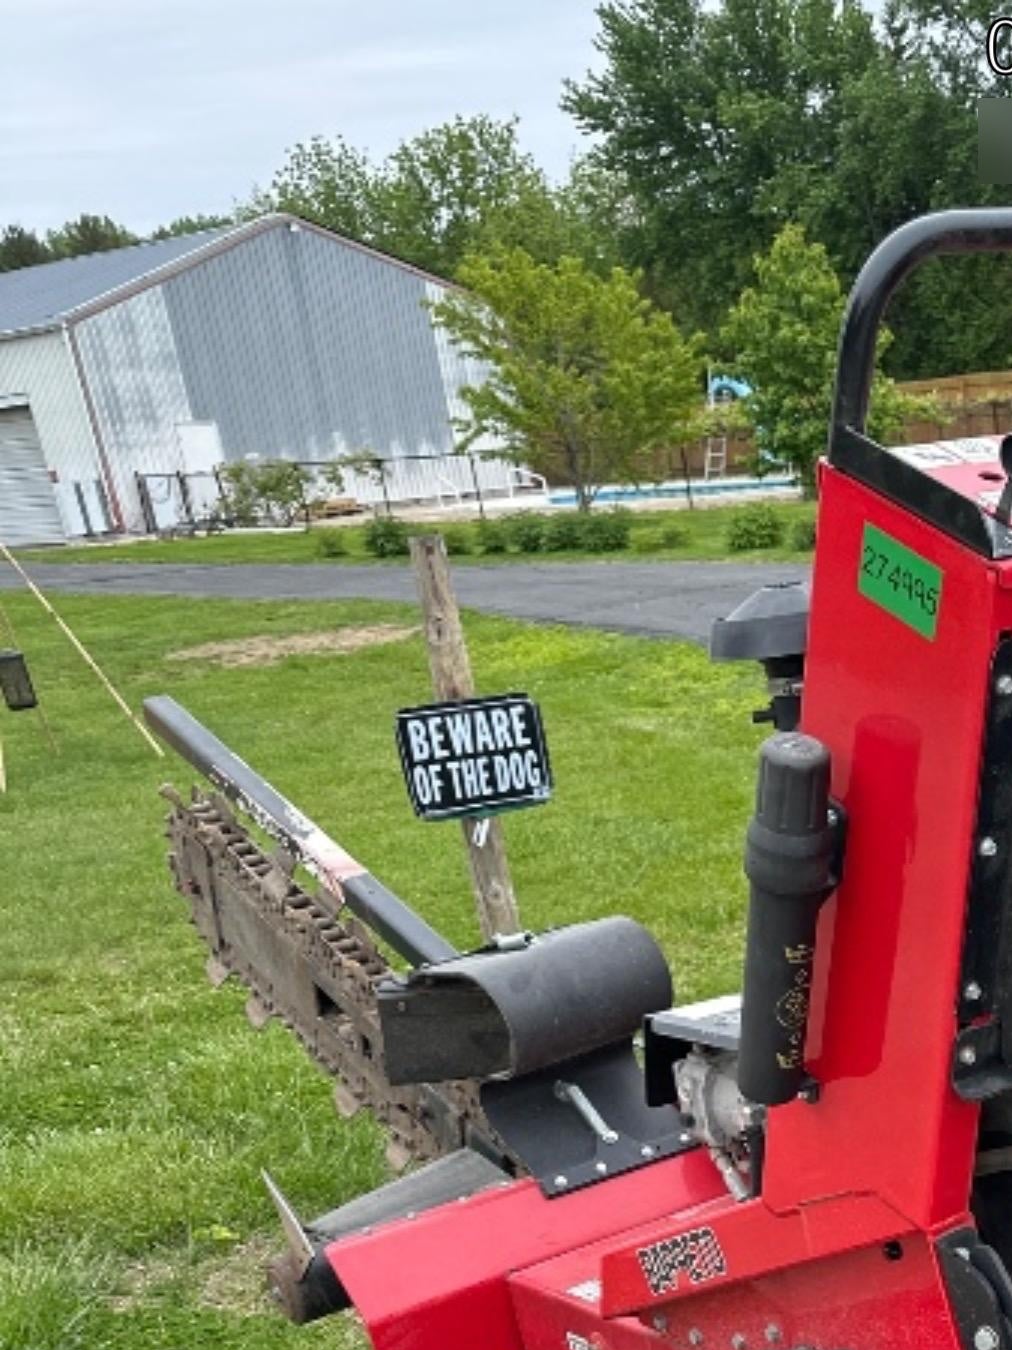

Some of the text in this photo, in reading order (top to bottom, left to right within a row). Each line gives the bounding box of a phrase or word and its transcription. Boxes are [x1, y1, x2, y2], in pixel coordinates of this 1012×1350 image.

[407, 704, 532, 762] BEWARE
[413, 750, 541, 805] OF THE DOG
